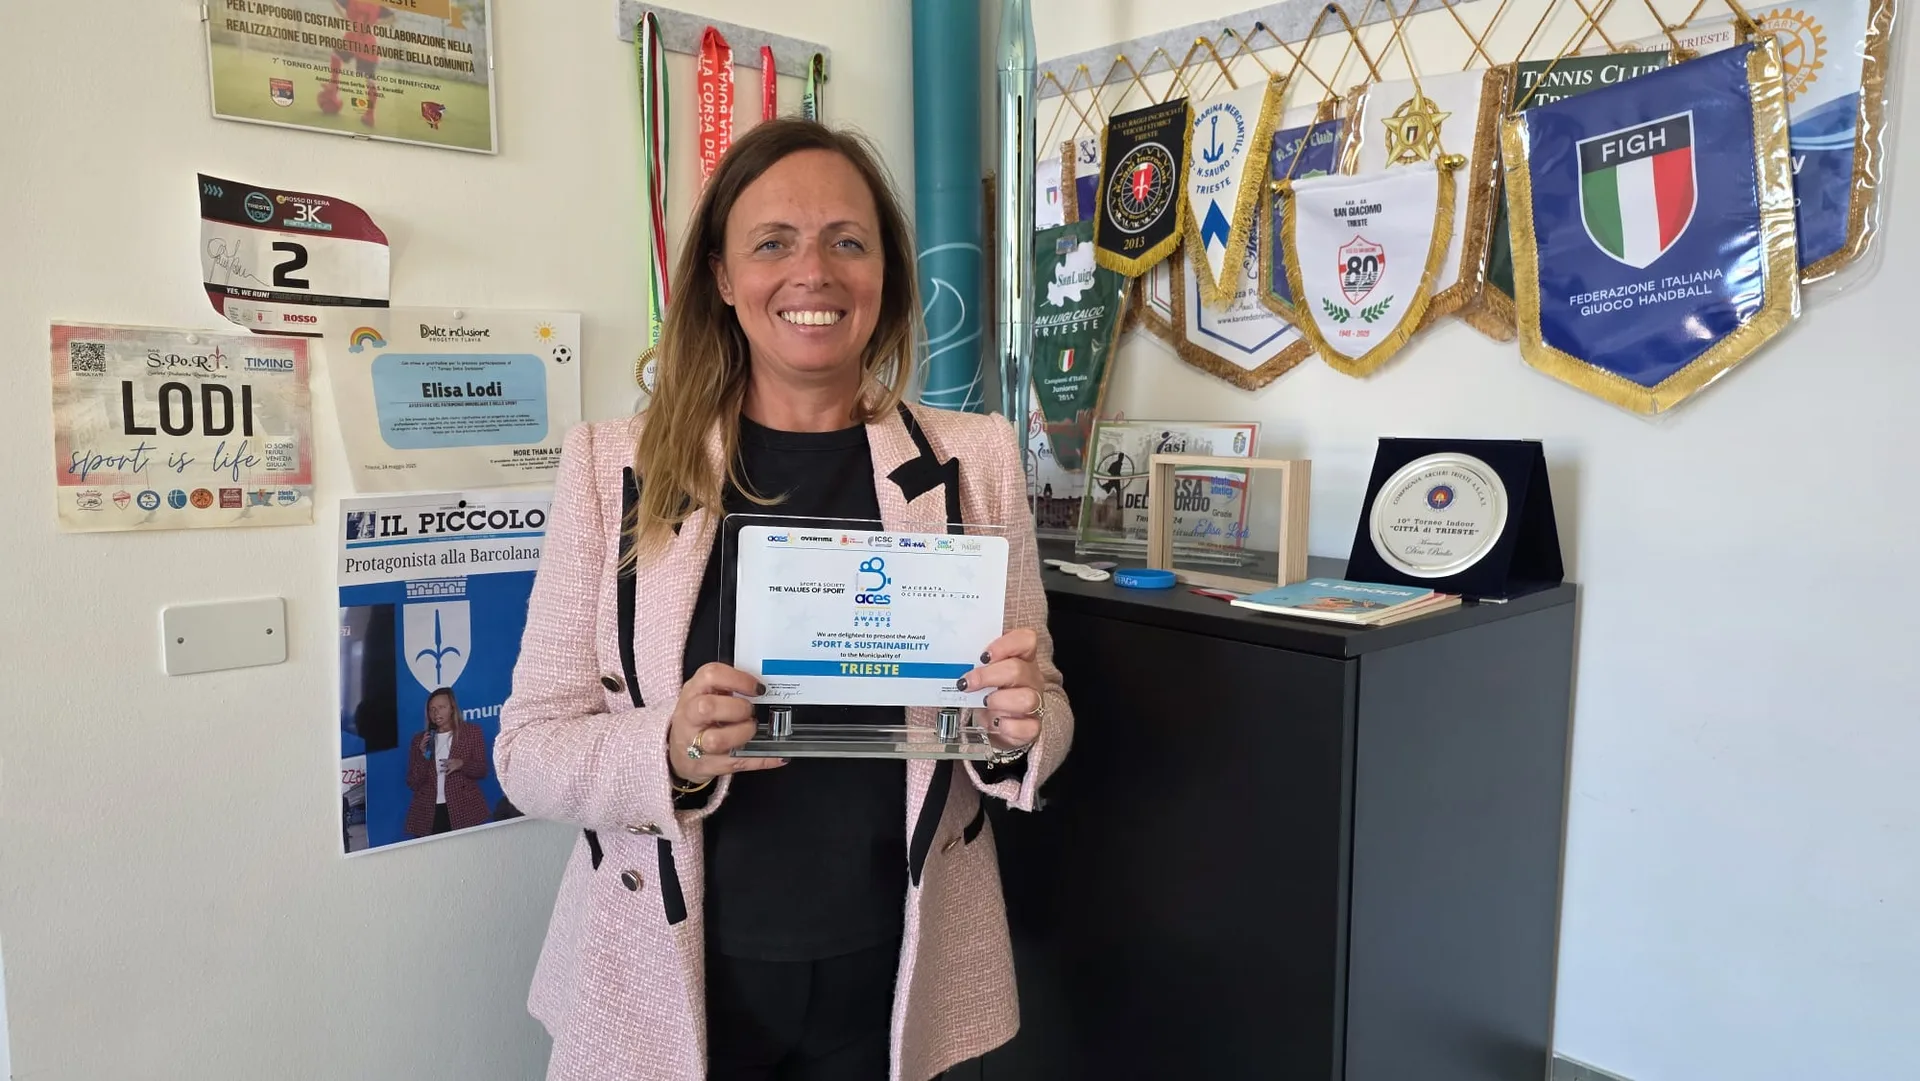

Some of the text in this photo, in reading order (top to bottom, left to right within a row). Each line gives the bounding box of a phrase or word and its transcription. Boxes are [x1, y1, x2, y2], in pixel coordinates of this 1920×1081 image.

[226, 0, 473, 55] PER L'APPOGGIO COSTANTE E LA COLLABORAZIONE NELLA
[226, 18, 475, 74] REALIZZAZIONE DEI PROGETTI A FAVORE DELLA COMUNITÀ
[1679, 31, 1730, 49] TRIESTE
[282, 59, 313, 70] TORNEO
[702, 58, 713, 77] LA
[1521, 69, 1594, 89] TENNIS
[703, 82, 715, 133] CORSA
[719, 119, 728, 157] ELLA
[1194, 103, 1245, 155] MARINA MERCANTILE
[1309, 129, 1334, 147] Club
[1601, 127, 1666, 163] FIGH
[1196, 159, 1230, 178] N.SAURO
[1196, 176, 1232, 194] TRIESTE
[293, 203, 322, 224] 3K
[1333, 203, 1382, 218] SAN GIACOMO
[1346, 218, 1368, 227] TRIESTE
[1123, 236, 1145, 250] 2013
[271, 241, 310, 290] 2
[1344, 255, 1379, 287] 80
[226, 287, 240, 296] YES,
[241, 289, 252, 297] WE
[253, 290, 270, 299] RUN!
[1569, 268, 1723, 306] FEDERAZIONE ITALIANA
[1580, 283, 1713, 317] GIUOCO HANDBALL
[283, 313, 318, 324] ROSSO
[1035, 305, 1105, 326] AN LUIGI CALCIO
[419, 323, 491, 339] Dolce inclusione
[244, 357, 294, 369] TIMING
[421, 381, 503, 398] Elisa Lodi
[1051, 384, 1079, 394] Juniores
[121, 380, 254, 437] LODI
[68, 439, 262, 483] sport is life
[513, 449, 531, 457] MORE
[531, 448, 548, 456] THAN
[1450, 470, 1472, 484] TRIESTE
[380, 508, 546, 537] IL PICCOLO
[1414, 518, 1443, 526] Torneo
[1446, 520, 1475, 528] Indoor
[1422, 526, 1431, 534] di
[1435, 527, 1480, 536] TRIESTE"
[874, 535, 893, 543] ICSC
[345, 545, 540, 574] Protagonista alla Barcolana
[854, 593, 891, 605] aces
[1333, 585, 1413, 597] PEDOCIN
[837, 631, 865, 640] delighted
[873, 633, 897, 641] present
[811, 640, 930, 651] SPORT & SUSTAINABILITY
[858, 652, 894, 660] Municipality
[840, 662, 900, 676] TRIESTE
